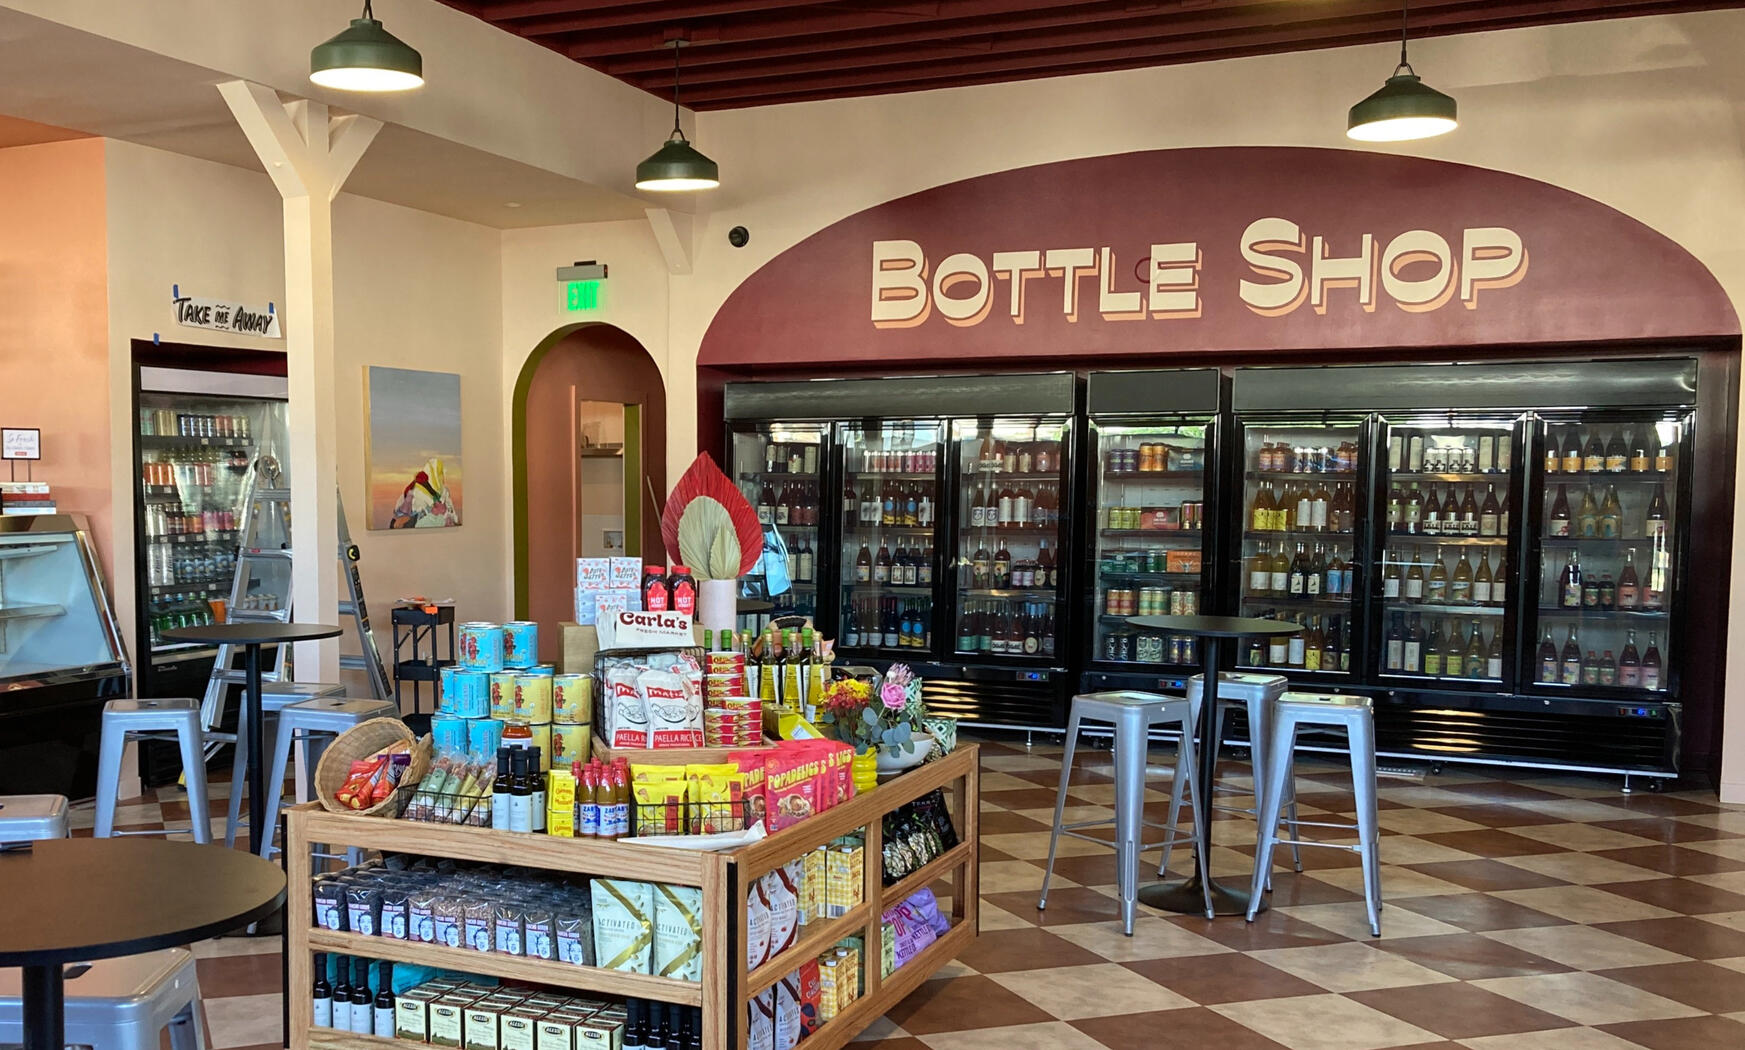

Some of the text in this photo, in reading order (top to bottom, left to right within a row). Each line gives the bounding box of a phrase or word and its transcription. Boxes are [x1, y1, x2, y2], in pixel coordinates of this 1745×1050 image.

[871, 217, 1529, 329] BOTTLE SHOP
[567, 280, 600, 311] EXIT
[173, 297, 273, 334] TAKE ME AWAY
[620, 612, 688, 630] Carla's
[616, 733, 639, 742] PAELLA
[654, 734, 679, 743] PAELLA
[768, 761, 819, 790] POPADELICS
